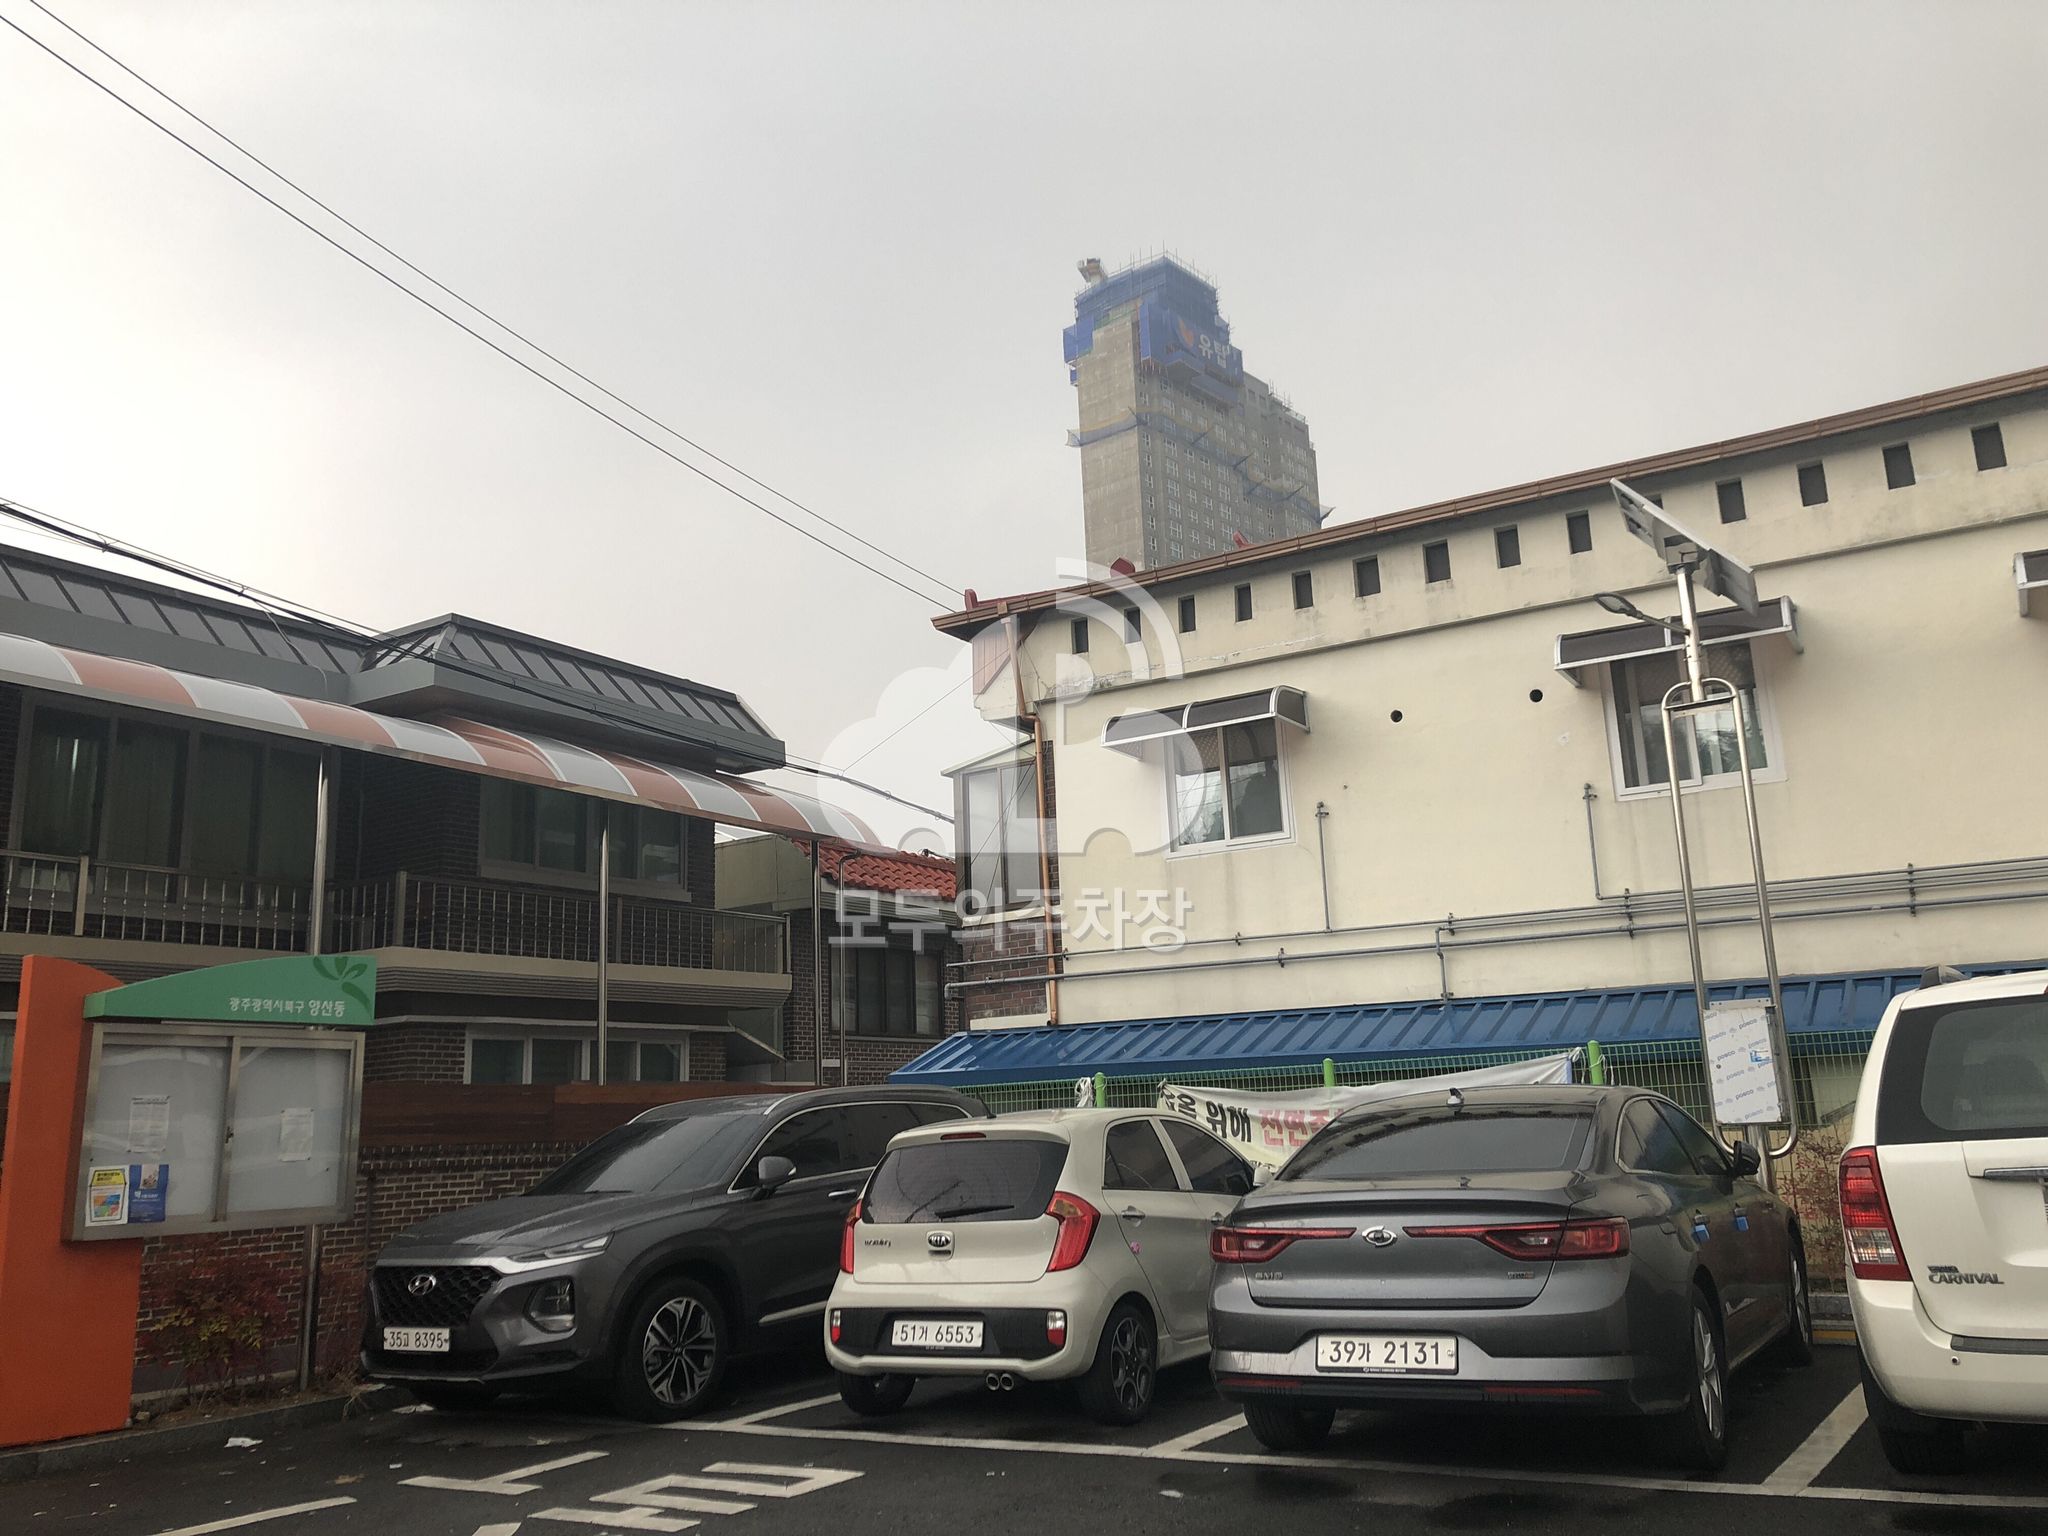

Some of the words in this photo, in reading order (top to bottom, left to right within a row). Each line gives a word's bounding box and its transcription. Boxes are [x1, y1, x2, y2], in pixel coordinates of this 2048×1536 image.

[1198, 334, 1230, 369] 유탑
[308, 999, 345, 1017] 양산동
[1206, 1100, 1251, 1142] 위해
[928, 1234, 951, 1248] KIA
[1928, 1273, 2004, 1285] CARNIVAL
[414, 1331, 444, 1349] 8395
[935, 1325, 975, 1343] 6553
[1329, 1341, 1371, 1363] 39가
[1384, 1341, 1439, 1365] 2131
